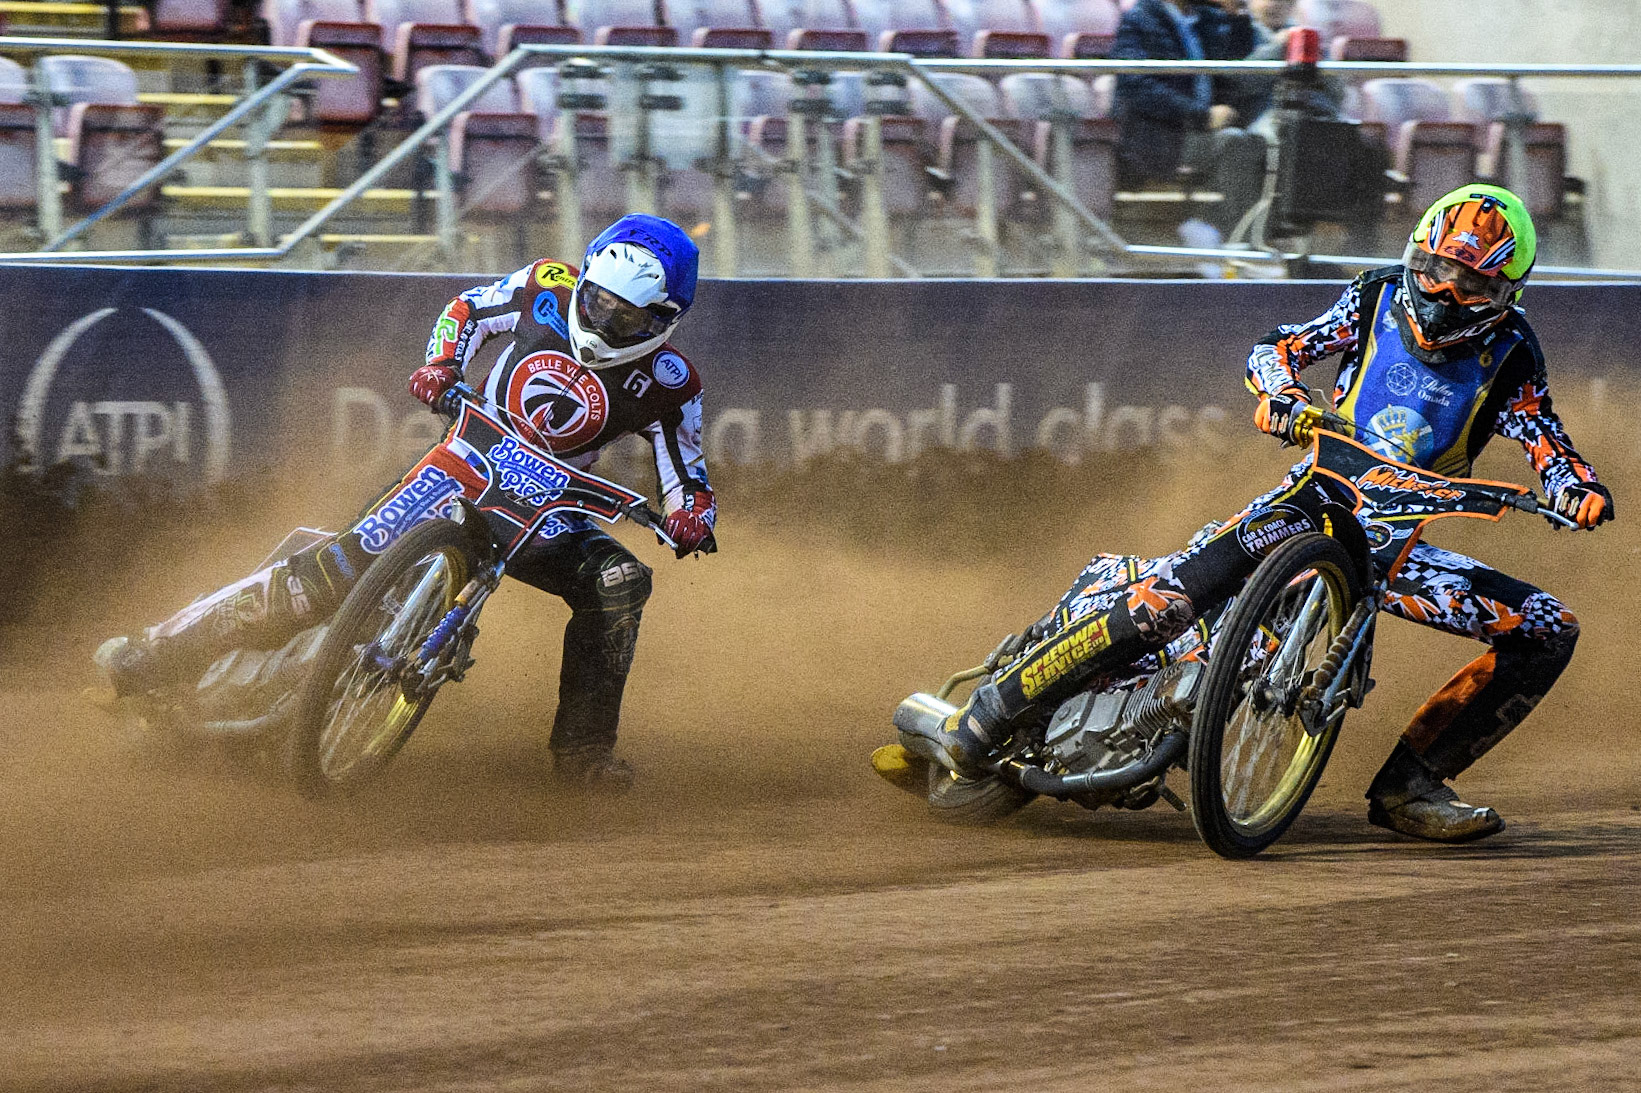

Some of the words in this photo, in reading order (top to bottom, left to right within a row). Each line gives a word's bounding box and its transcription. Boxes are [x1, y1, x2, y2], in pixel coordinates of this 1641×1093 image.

[527, 359, 562, 374] BELLE
[585, 384, 602, 421] COLTS
[660, 359, 683, 381] ATPI
[789, 383, 1013, 465] world
[490, 437, 569, 489] Bowen
[355, 466, 448, 553] Bowen
[1242, 531, 1258, 544] CAR
[1264, 519, 1287, 533] COACH
[1246, 518, 1311, 553] TRIMMERS
[1021, 613, 1112, 699] SPEEDWAY
